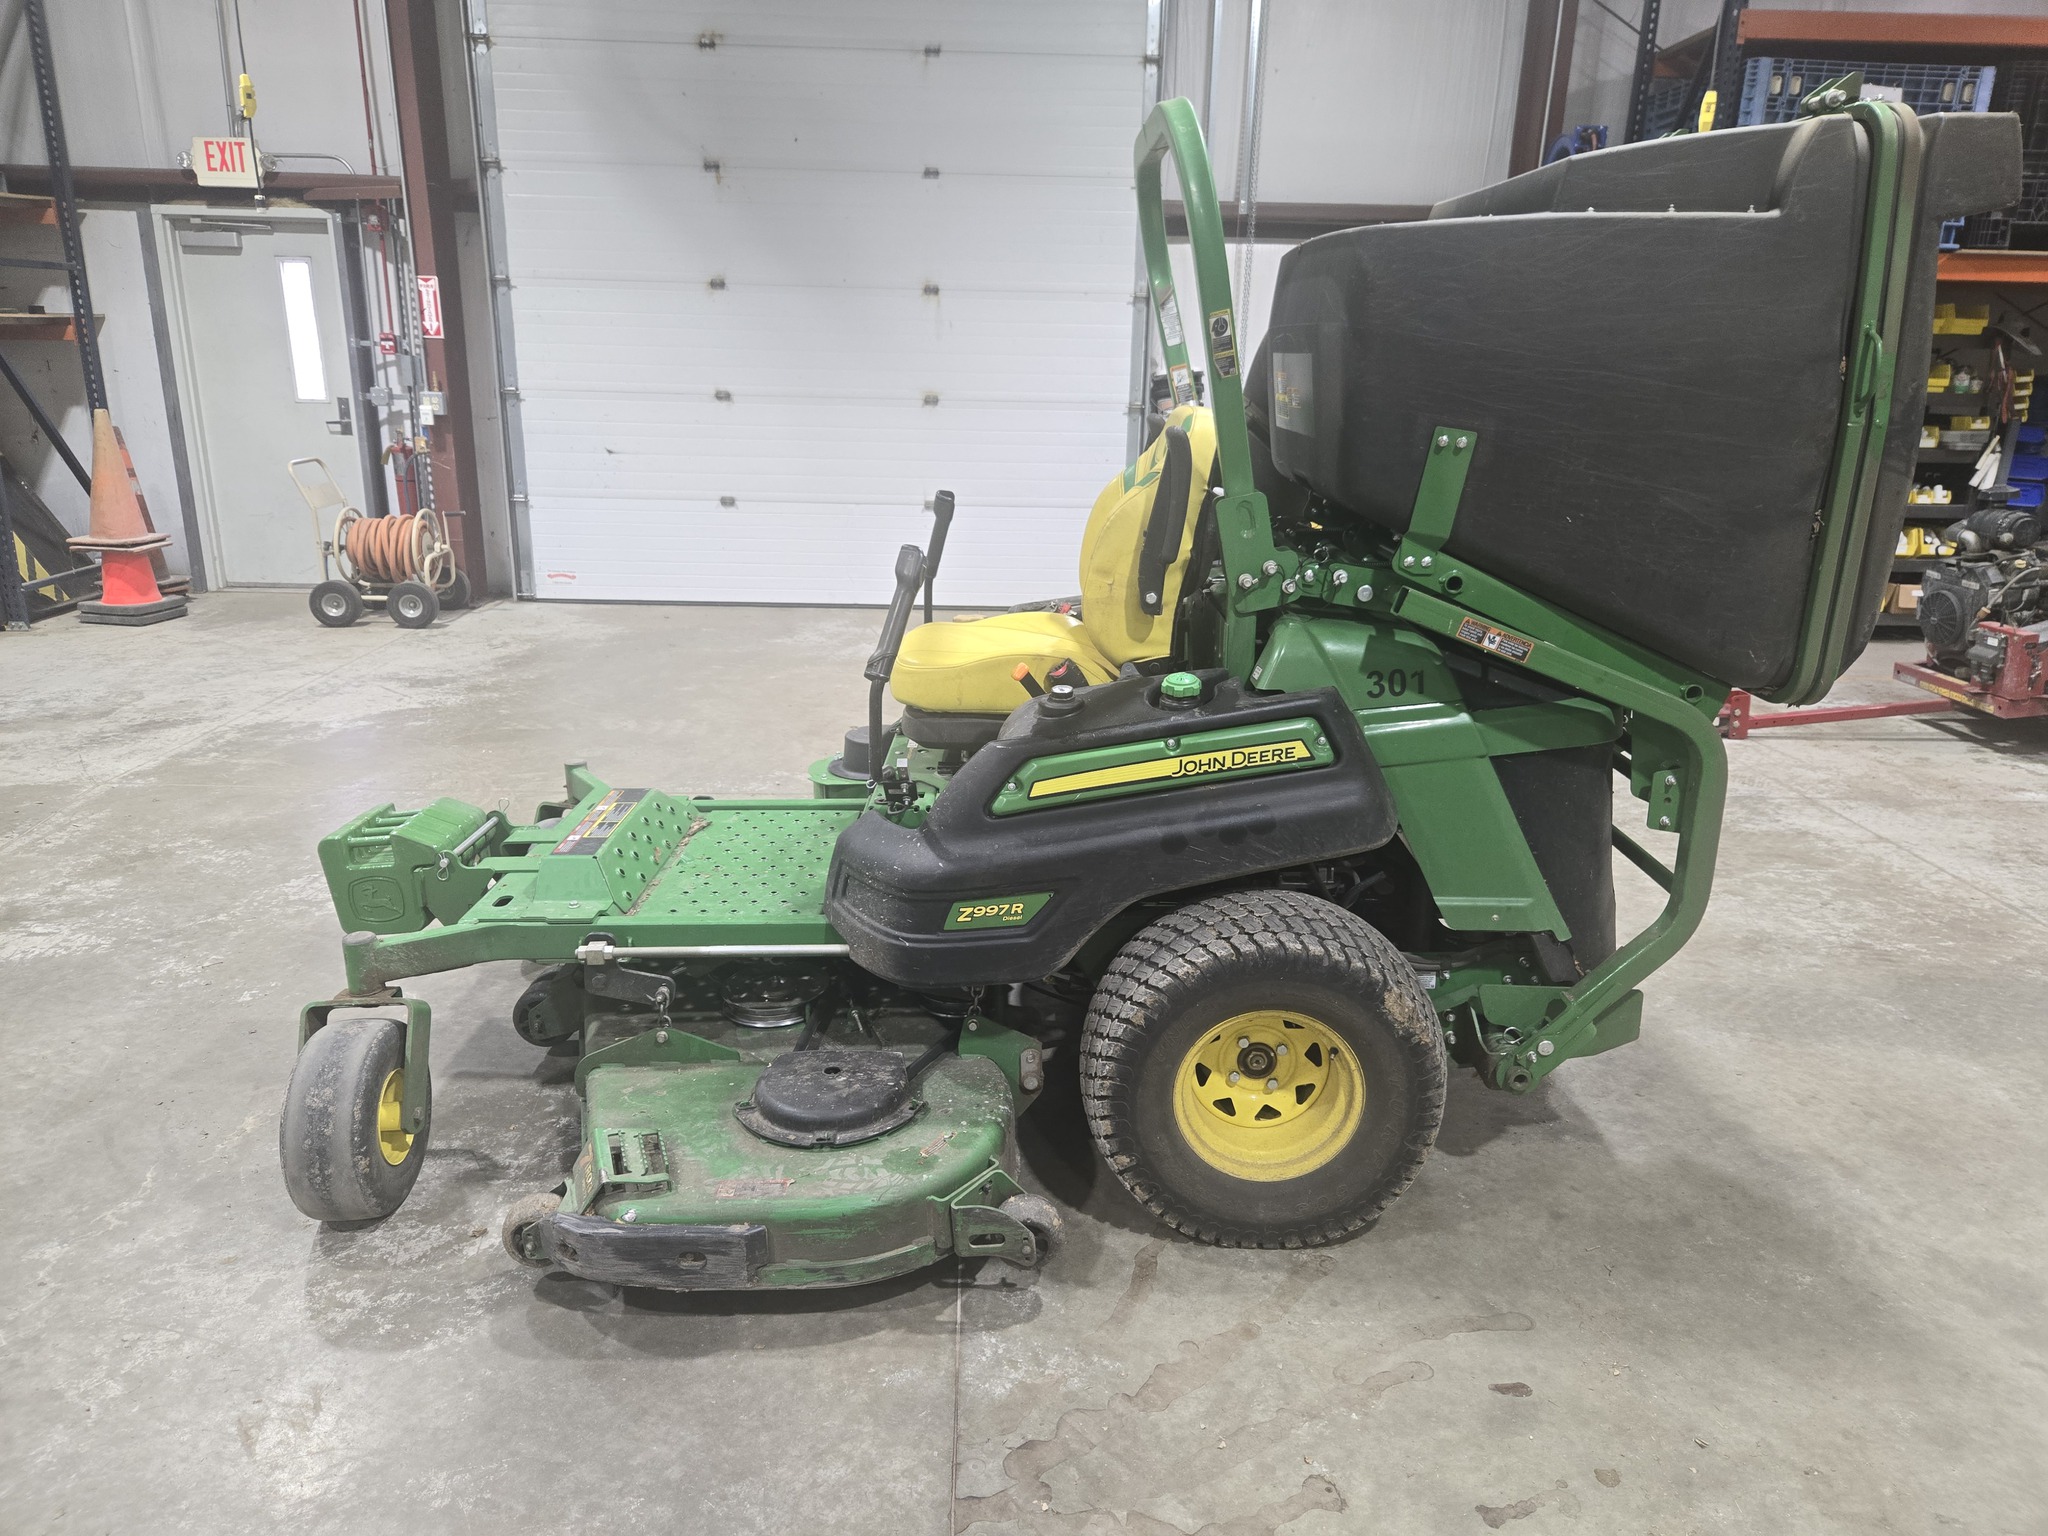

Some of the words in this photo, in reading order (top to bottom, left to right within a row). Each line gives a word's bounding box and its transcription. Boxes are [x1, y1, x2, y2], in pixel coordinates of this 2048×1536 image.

[203, 141, 245, 172] EXIT
[1366, 669, 1424, 698] 301
[1171, 756, 1226, 775] JOHN
[1231, 747, 1296, 766] DEERE
[957, 903, 1024, 922] Z997R
[1002, 914, 1023, 922] Diesel
